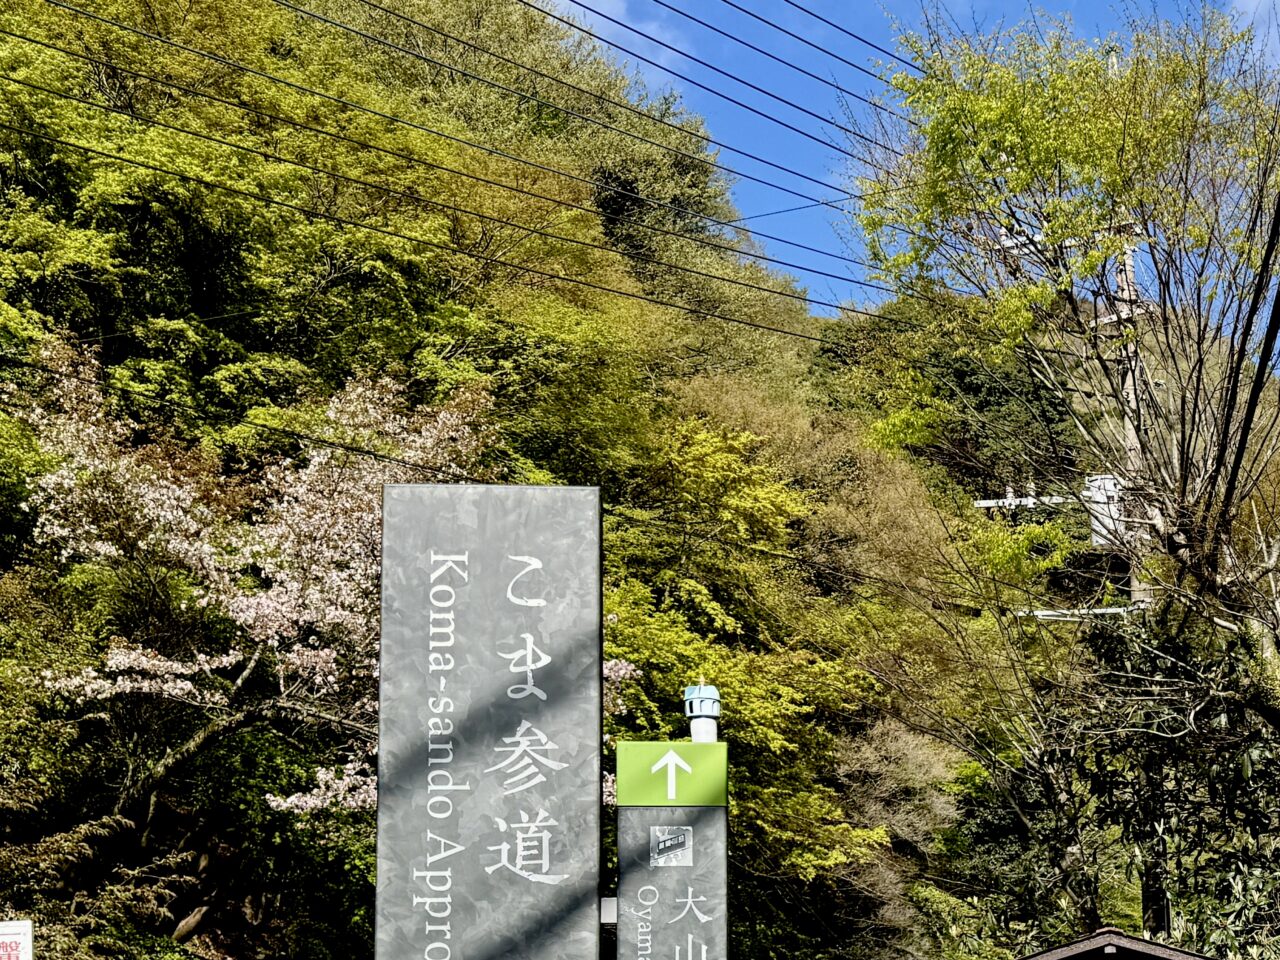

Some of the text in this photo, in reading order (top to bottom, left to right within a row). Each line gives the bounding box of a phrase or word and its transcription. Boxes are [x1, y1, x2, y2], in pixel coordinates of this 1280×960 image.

[427, 549, 470, 819] Koma-sando
[484, 554, 570, 884] こま参道
